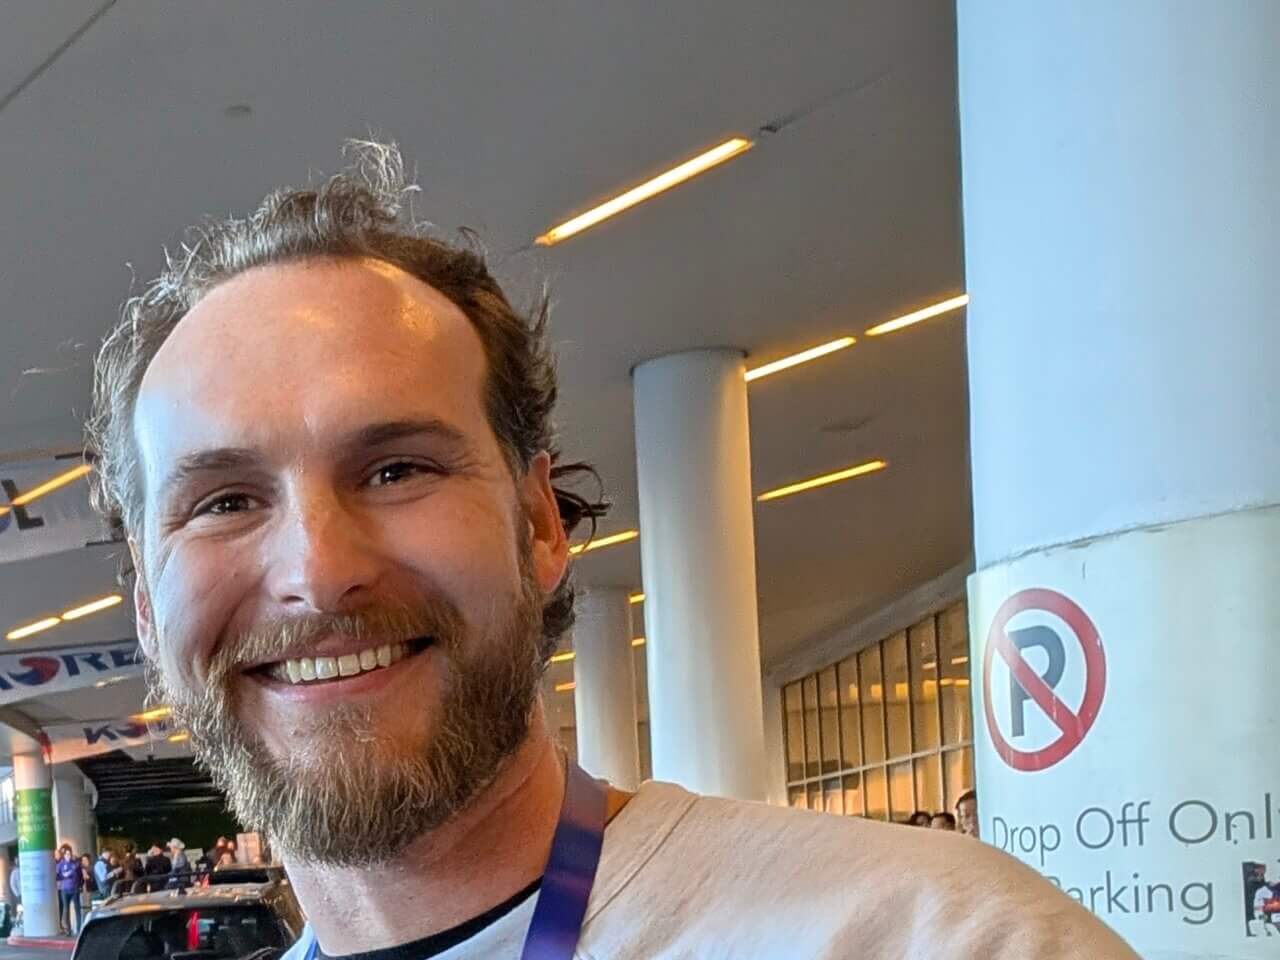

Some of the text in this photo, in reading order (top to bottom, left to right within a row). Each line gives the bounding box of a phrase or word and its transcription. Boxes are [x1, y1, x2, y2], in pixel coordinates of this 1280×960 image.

[992, 793, 1280, 867] Drop Off Onl
[1043, 870, 1214, 925] arking
